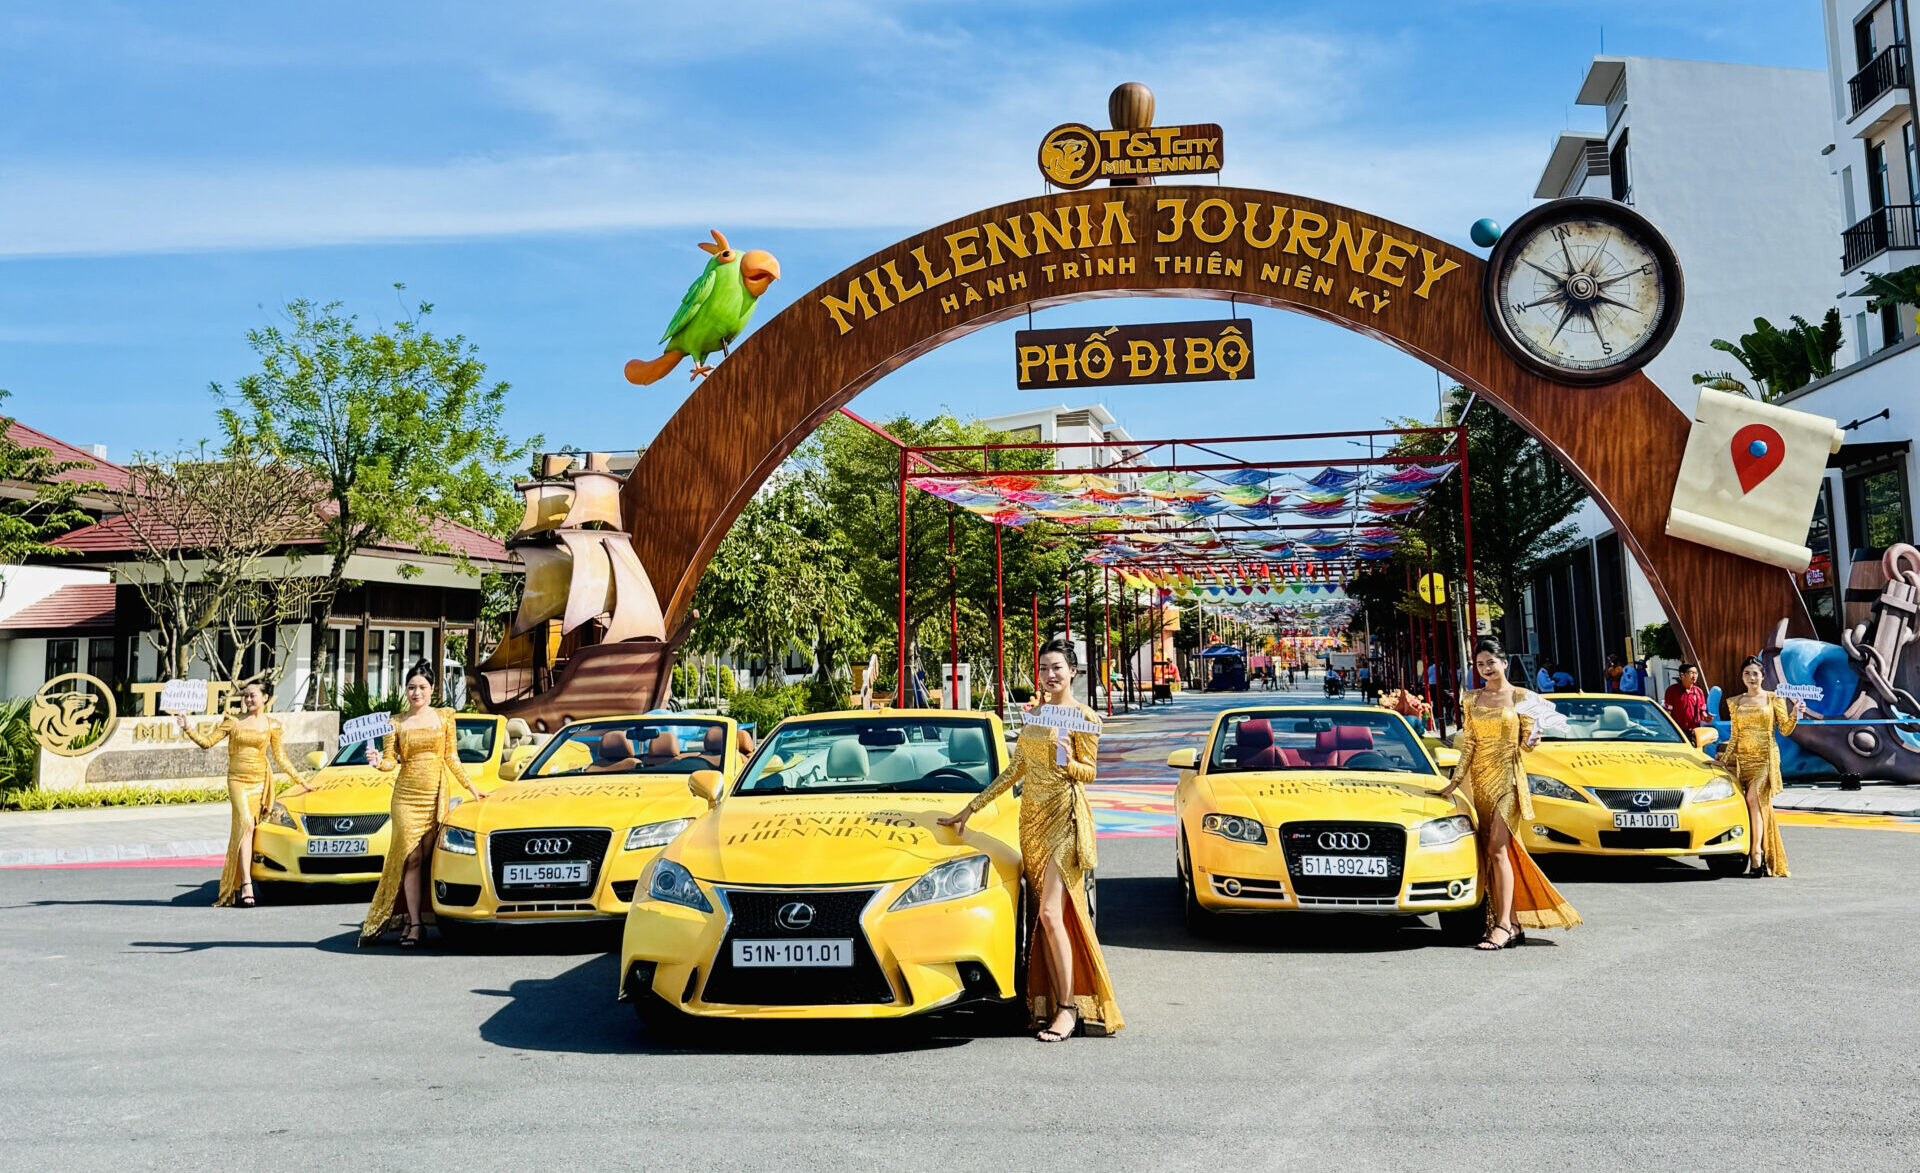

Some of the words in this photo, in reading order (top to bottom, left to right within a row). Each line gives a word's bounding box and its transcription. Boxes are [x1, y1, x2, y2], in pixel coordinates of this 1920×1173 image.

[1102, 155, 1220, 174] MILLENNIA
[820, 201, 1136, 335] MILLENNIA
[1157, 198, 1461, 299] JOURNEY
[1641, 263, 1653, 275] E
[940, 271, 1027, 314] HÀNH
[1042, 254, 1136, 283] TRÌNH
[1155, 251, 1243, 277] THIÊN
[1260, 263, 1334, 296] NIÊN
[1348, 287, 1390, 314] KỶ
[1511, 302, 1527, 315] W
[1019, 325, 1119, 383] PHỐ
[1122, 338, 1177, 377] ĐI
[1184, 325, 1250, 380] BỘ
[1602, 342, 1613, 355] S
[340, 724, 394, 745] Millennia
[510, 866, 581, 881] 51L-580.75
[1305, 858, 1385, 875] 51A-892.45
[743, 945, 840, 962] 51N-101.01
